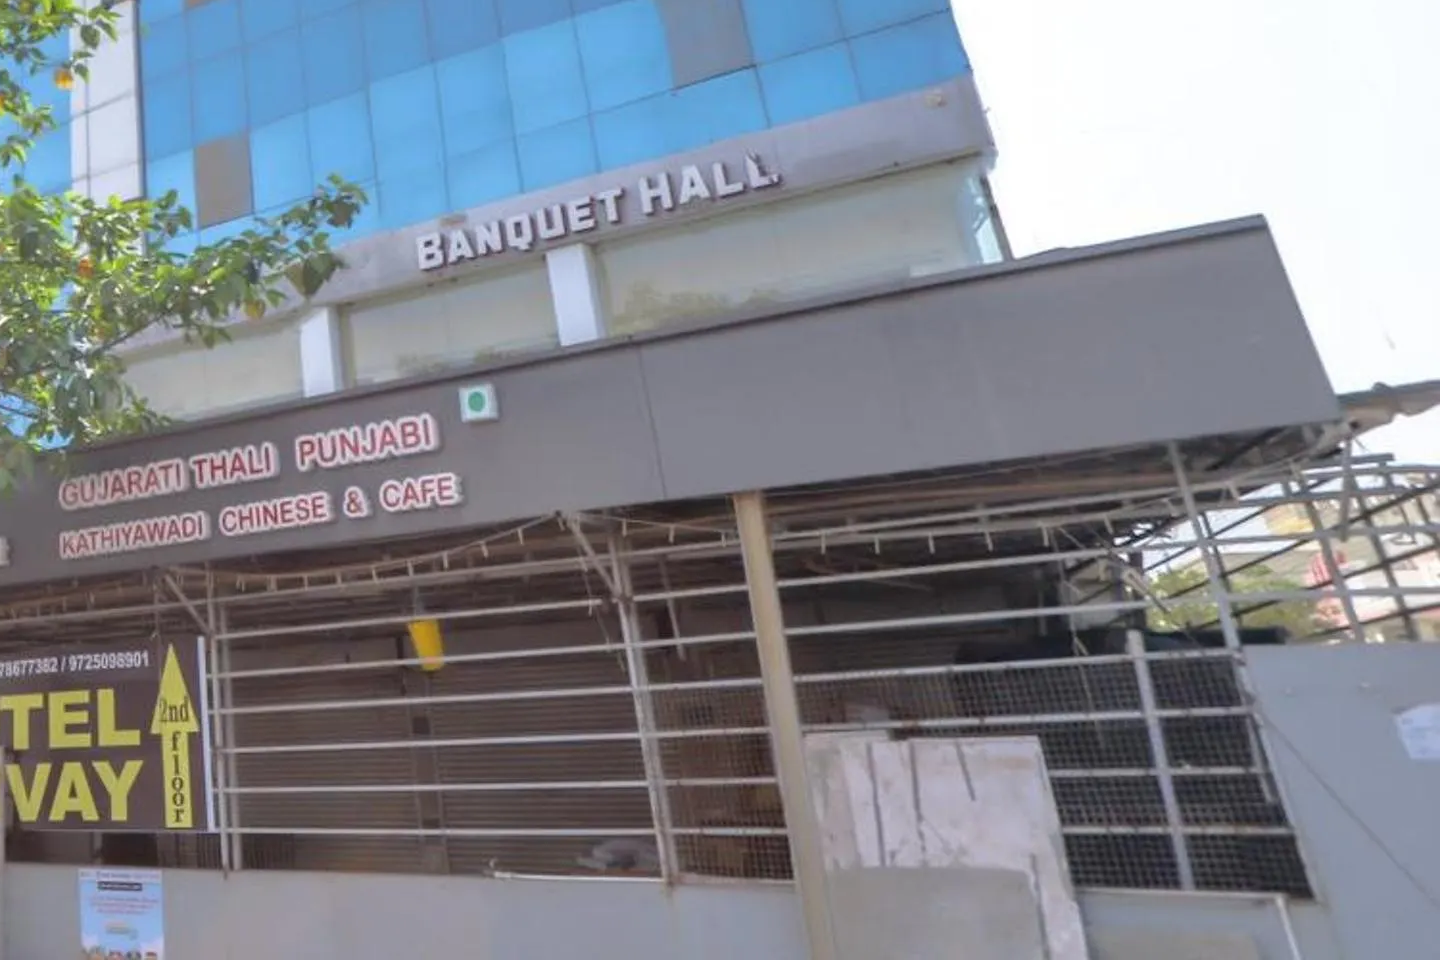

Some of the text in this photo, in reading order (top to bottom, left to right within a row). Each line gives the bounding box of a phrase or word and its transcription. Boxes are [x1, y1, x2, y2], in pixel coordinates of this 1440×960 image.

[417, 152, 781, 271] BANQUET HALL
[61, 414, 436, 510] GUJARATI THALI PUNJABI
[61, 473, 460, 559] KATHIYAWADI CHINESE & CAFE
[159, 696, 189, 722] 2nd
[171, 731, 185, 823] floor
